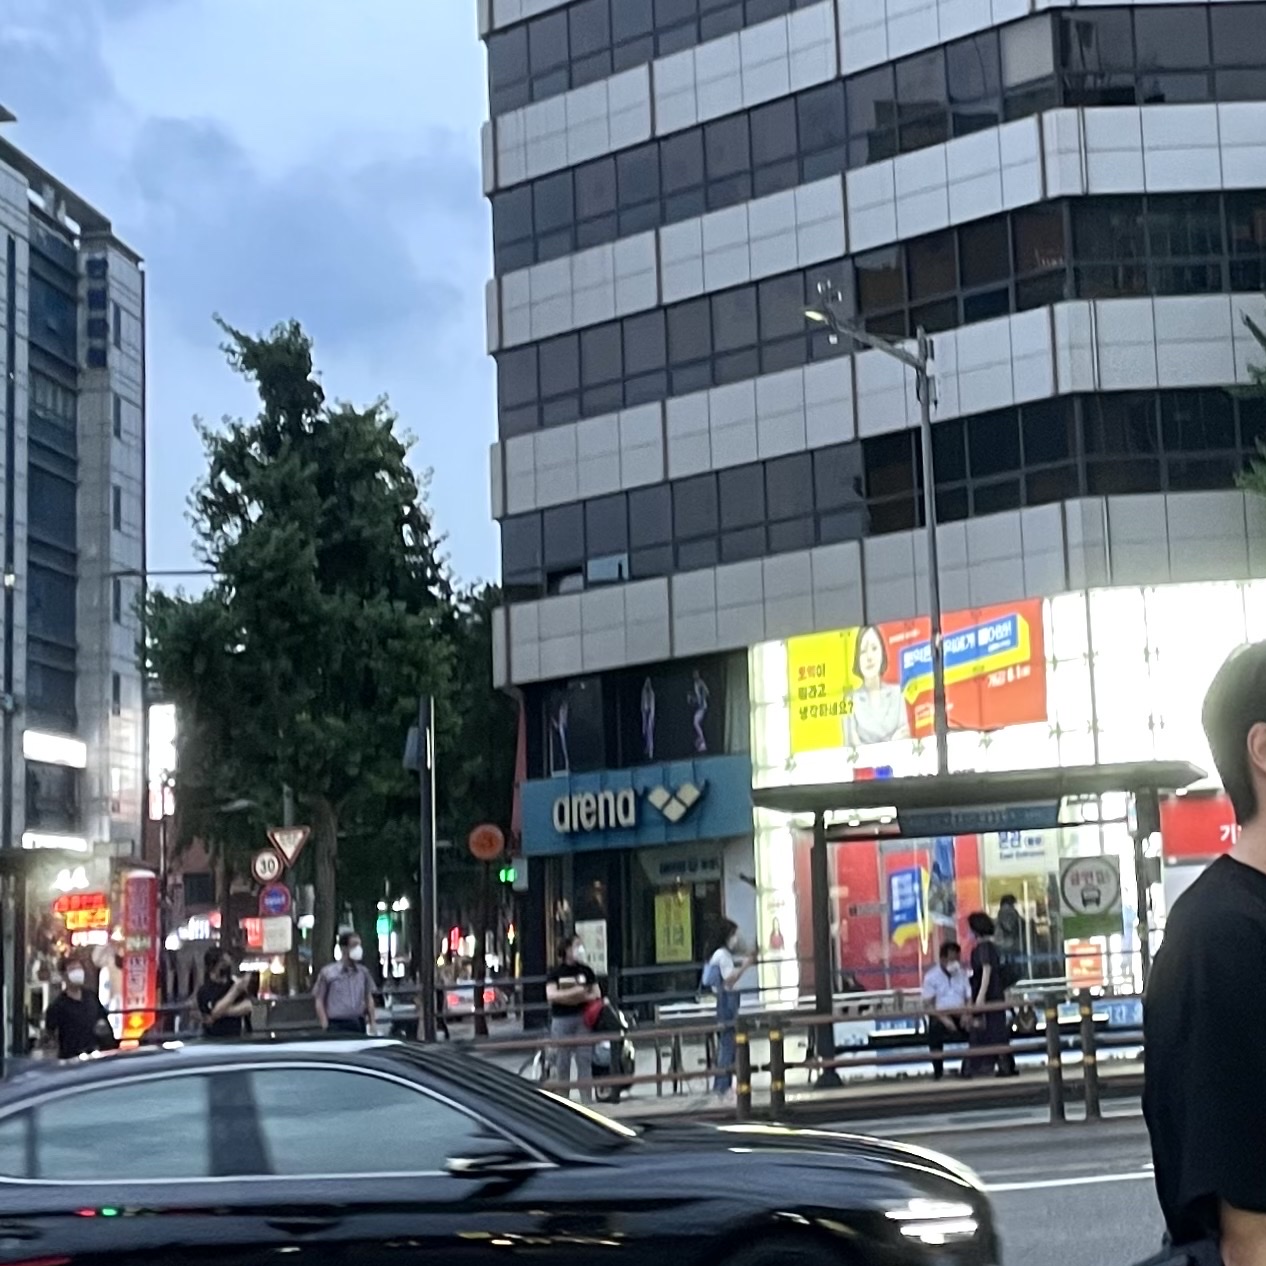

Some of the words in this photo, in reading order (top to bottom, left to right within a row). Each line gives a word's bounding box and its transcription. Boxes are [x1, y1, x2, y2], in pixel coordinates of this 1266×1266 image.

[799, 701, 854, 721] 생각하세요?
[553, 788, 635, 833] arena
[1219, 823, 1242, 845] 기
[260, 859, 276, 875] 30
